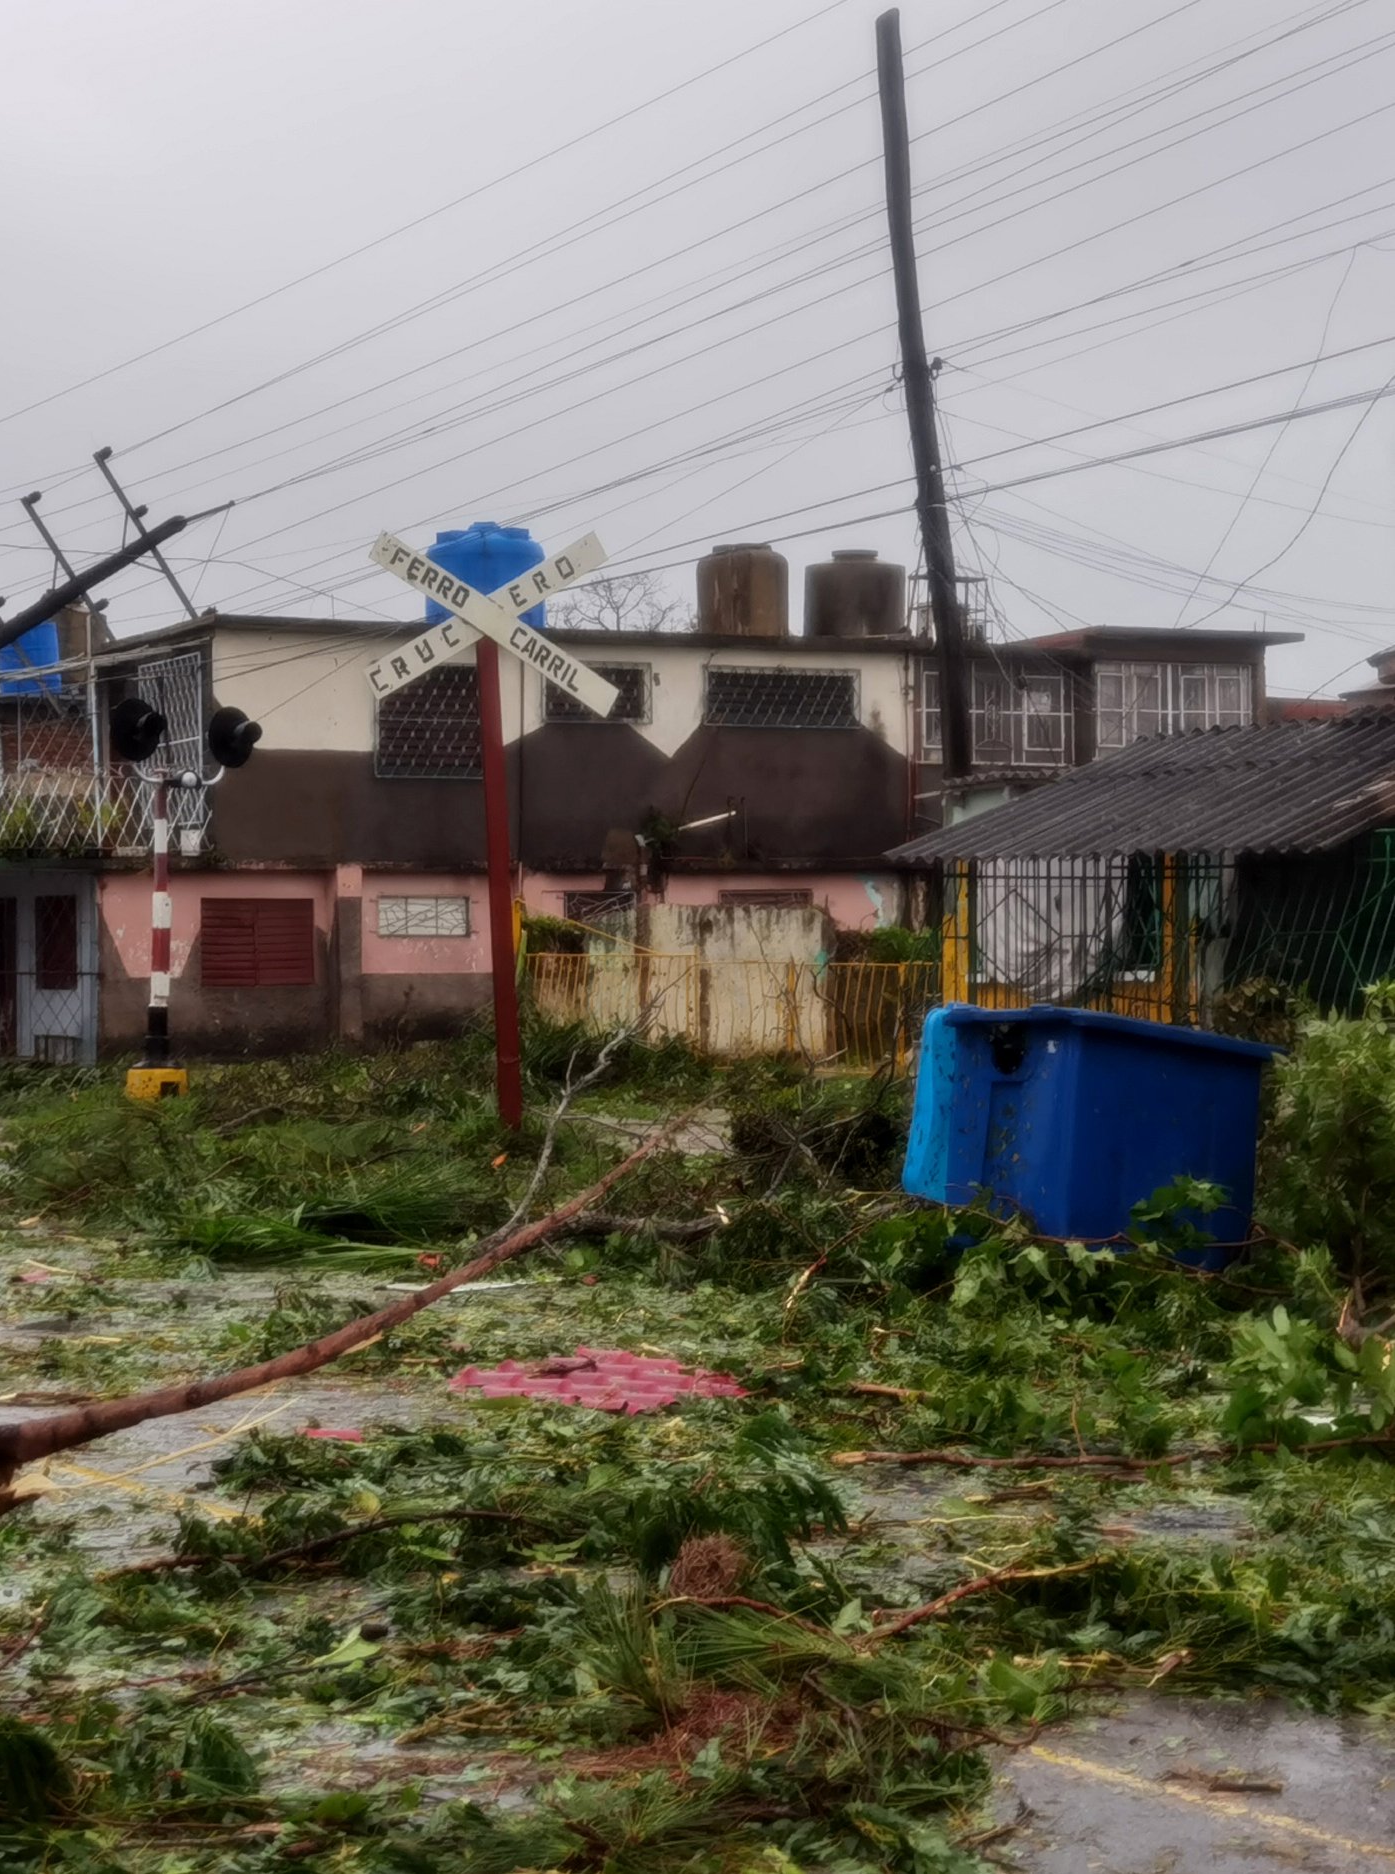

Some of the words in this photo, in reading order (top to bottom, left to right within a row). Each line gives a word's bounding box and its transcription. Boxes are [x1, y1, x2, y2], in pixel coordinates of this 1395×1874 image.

[369, 623, 460, 692] CRUC
[508, 555, 575, 607] ERO
[389, 546, 470, 609] FERRO
[509, 626, 579, 693] CARRIL
